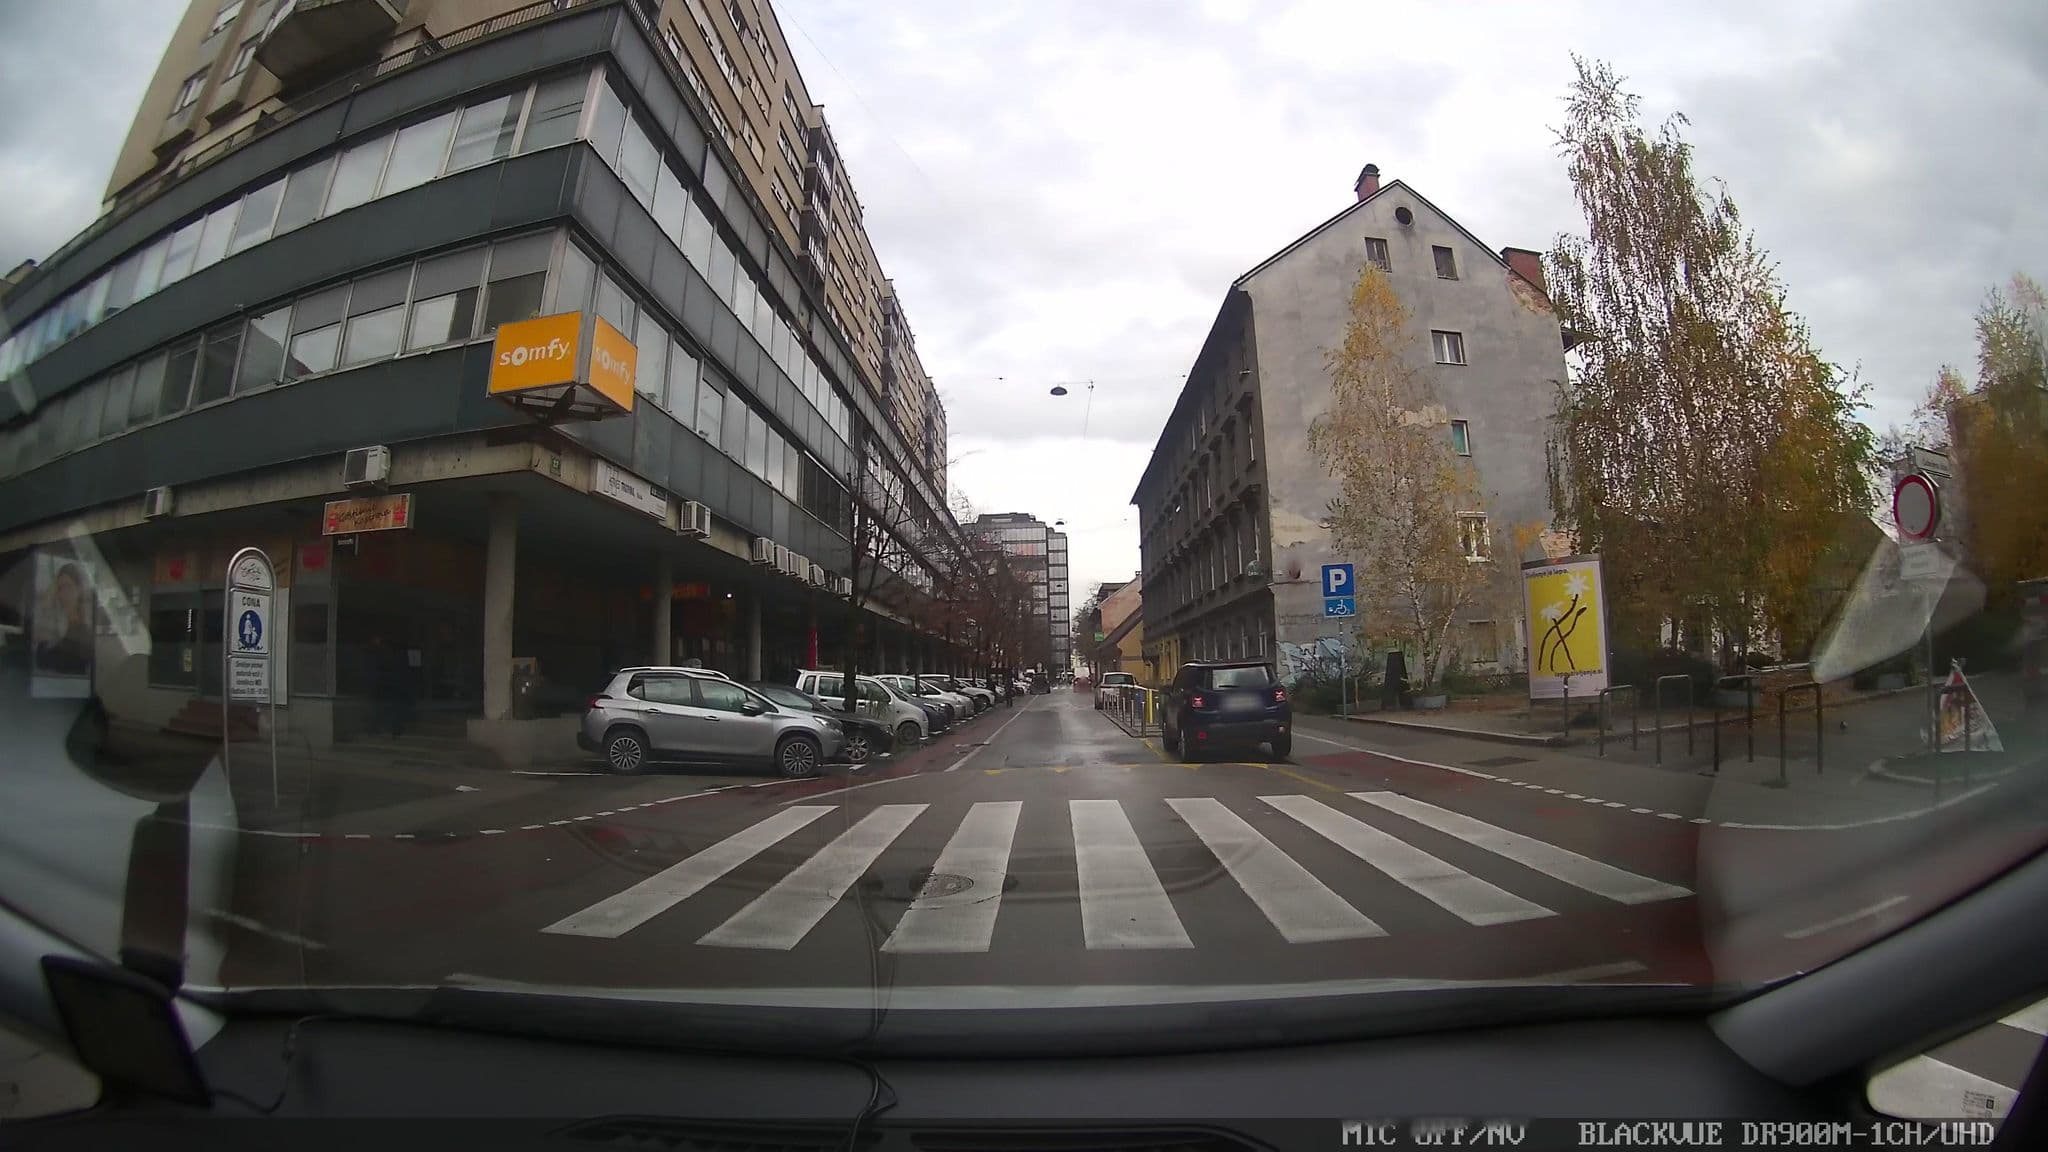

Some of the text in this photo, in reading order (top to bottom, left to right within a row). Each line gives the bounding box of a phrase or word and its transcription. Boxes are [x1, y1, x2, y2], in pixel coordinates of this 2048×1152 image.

[500, 338, 570, 366] somfy
[595, 346, 631, 384] somfy
[1329, 569, 1346, 592] P
[241, 596, 261, 608] CONA
